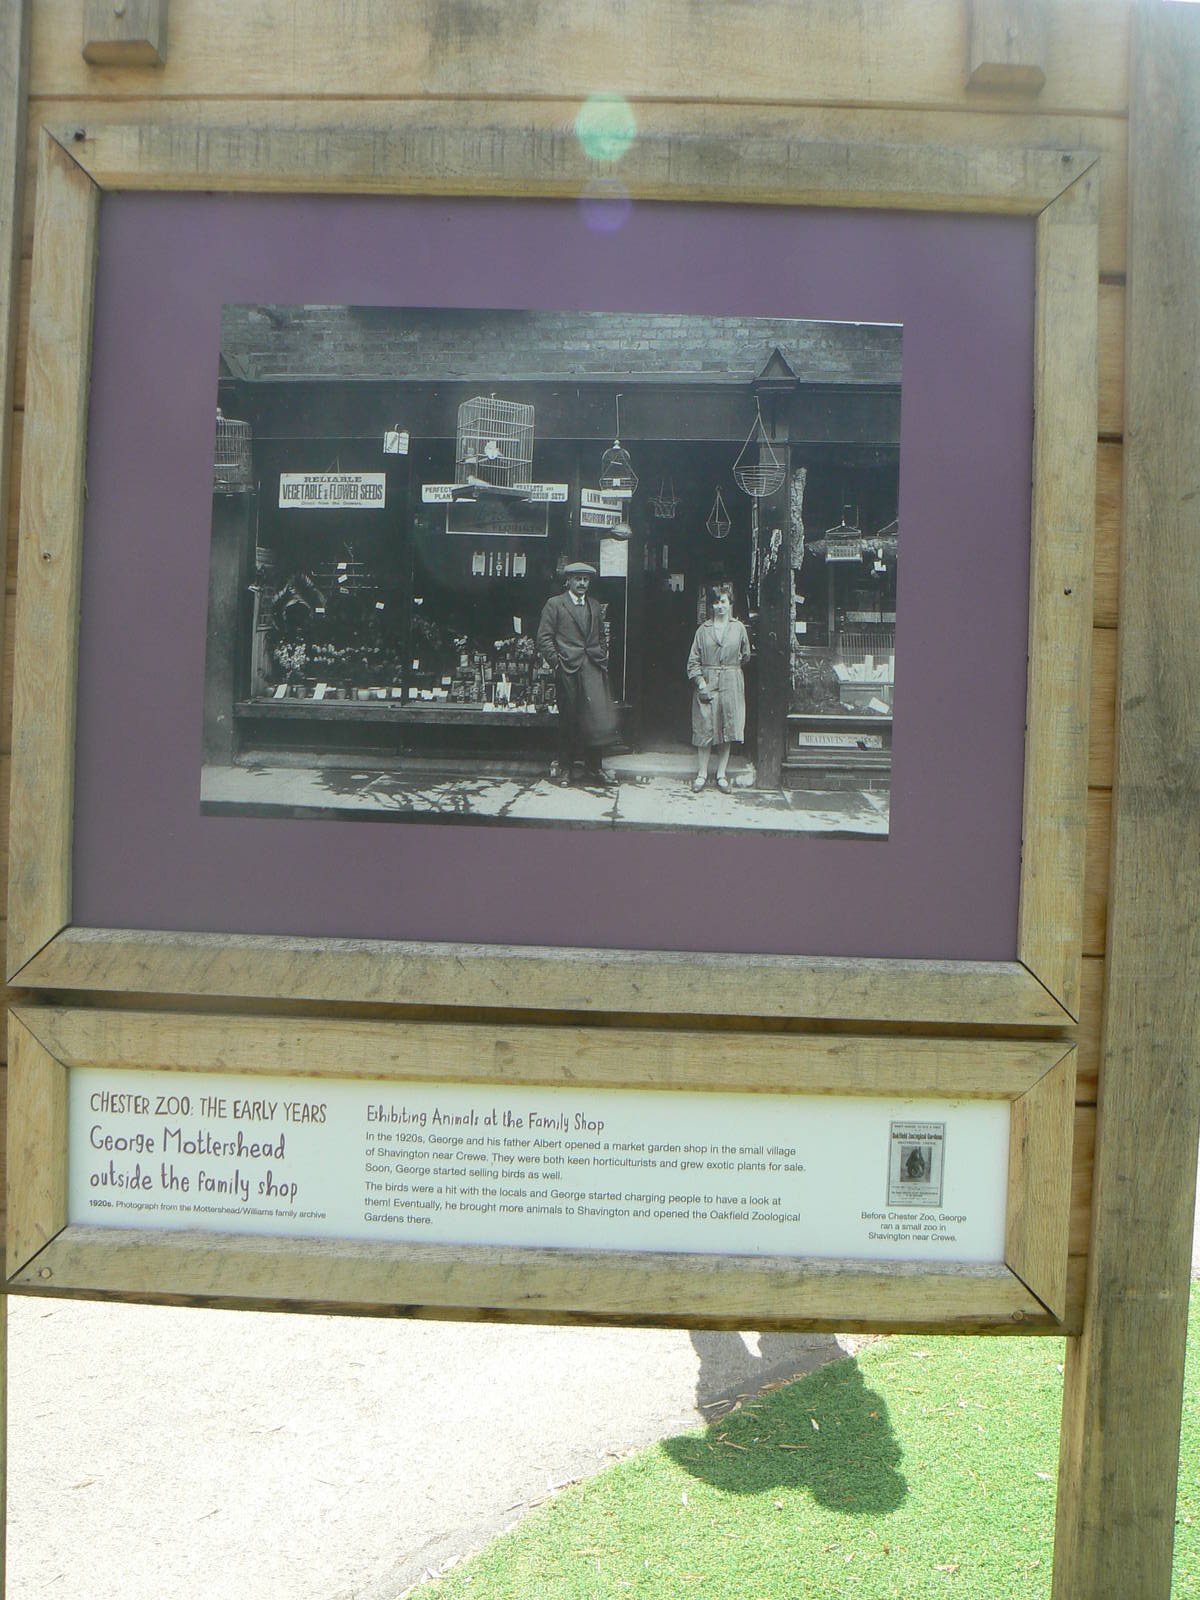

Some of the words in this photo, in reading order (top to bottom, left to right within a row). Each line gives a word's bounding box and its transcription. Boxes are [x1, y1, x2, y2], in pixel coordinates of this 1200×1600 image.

[282, 484, 323, 500] VEGETABLE
[329, 484, 359, 500] FLOWER
[360, 484, 383, 500] SEEDS
[90, 1091, 150, 1115] CHESTER
[154, 1096, 193, 1116] ZOO:
[200, 1096, 227, 1118] THE
[233, 1100, 278, 1121] EARLY
[283, 1102, 327, 1123] YEARS
[367, 1105, 427, 1127] Exhibiting
[432, 1108, 479, 1128] Animals
[484, 1108, 498, 1127] at
[503, 1111, 525, 1128] the
[529, 1112, 569, 1133] Family
[574, 1112, 604, 1137] Shop
[90, 1125, 154, 1153] George
[163, 1127, 285, 1159] Mottershead
[366, 1131, 375, 1140] In
[377, 1132, 392, 1142] the
[395, 1132, 426, 1144] 1920s,
[428, 1134, 464, 1147] George
[467, 1136, 484, 1146] and
[487, 1135, 501, 1147] his
[504, 1136, 531, 1148] father
[533, 1138, 563, 1148] Albert
[563, 1139, 601, 1150] opened
[603, 1143, 609, 1151] a
[612, 1142, 646, 1151] market
[648, 1144, 681, 1154] garden
[683, 1144, 708, 1154] shop
[710, 1144, 719, 1153] in
[721, 1145, 737, 1154] the
[739, 1146, 763, 1155] small
[766, 1146, 796, 1158] village
[365, 1147, 375, 1156] of
[377, 1147, 430, 1160] Shavington
[432, 1152, 454, 1161] near
[456, 1151, 489, 1162] Crewe.
[491, 1151, 515, 1165] They
[517, 1155, 540, 1164] were
[543, 1153, 565, 1165] both
[568, 1154, 590, 1165] keen
[593, 1156, 657, 1167] horticulturists
[659, 1159, 678, 1168] and
[679, 1161, 704, 1170] grew
[707, 1160, 734, 1170] exotic
[737, 1160, 766, 1172] plants
[768, 1161, 782, 1171] for
[783, 1162, 806, 1172] sale.
[365, 1162, 392, 1174] Soon,
[395, 1163, 432, 1176] George
[432, 1166, 466, 1176] started
[469, 1168, 499, 1180] selling
[502, 1168, 525, 1178] birds
[526, 1171, 540, 1179] as
[542, 1171, 563, 1180] well.
[90, 1160, 153, 1190] outside
[161, 1162, 190, 1192] the
[198, 1169, 249, 1202] family
[258, 1170, 297, 1204] shop
[365, 1180, 384, 1190] The
[385, 1182, 409, 1193] birds
[410, 1185, 435, 1194] were
[436, 1185, 444, 1193] a
[445, 1184, 459, 1194] hit
[459, 1185, 479, 1195] with
[482, 1187, 498, 1196] the
[498, 1187, 527, 1197] locals
[530, 1189, 548, 1198] and
[550, 1189, 586, 1201] George
[588, 1192, 622, 1202] started
[625, 1192, 665, 1203] charging
[667, 1194, 701, 1204] people
[703, 1195, 713, 1203] to
[716, 1195, 739, 1204] have
[740, 1197, 747, 1205] a
[749, 1196, 769, 1205] look
[772, 1197, 781, 1207] at
[89, 1200, 114, 1208] 1920s.
[116, 1200, 159, 1211] Photograph
[160, 1201, 179, 1211] from
[179, 1202, 191, 1211] the
[193, 1203, 274, 1216] Mottershead/Williams
[275, 1207, 297, 1219] family
[299, 1209, 326, 1219] archive
[364, 1211, 405, 1223] Gardens
[406, 1214, 432, 1224] there.
[365, 1197, 391, 1207] them!
[393, 1198, 444, 1211] Eventually,
[445, 1200, 458, 1210] he
[460, 1200, 496, 1213] brought
[526, 1203, 563, 1214] animals
[565, 1206, 574, 1214] to
[577, 1205, 631, 1218] Shavington
[633, 1208, 650, 1217] and
[653, 1209, 690, 1220] opened
[691, 1209, 707, 1219] the
[710, 1209, 749, 1220] Oakfield
[750, 1210, 800, 1223] Zoological
[861, 1211, 886, 1220] Before
[887, 1212, 918, 1220] Chester
[918, 1213, 936, 1221] Zoo,
[939, 1213, 967, 1224] George
[868, 1231, 910, 1242] Shavington
[931, 1233, 957, 1242] Crewe.
[940, 1223, 946, 1231] in
